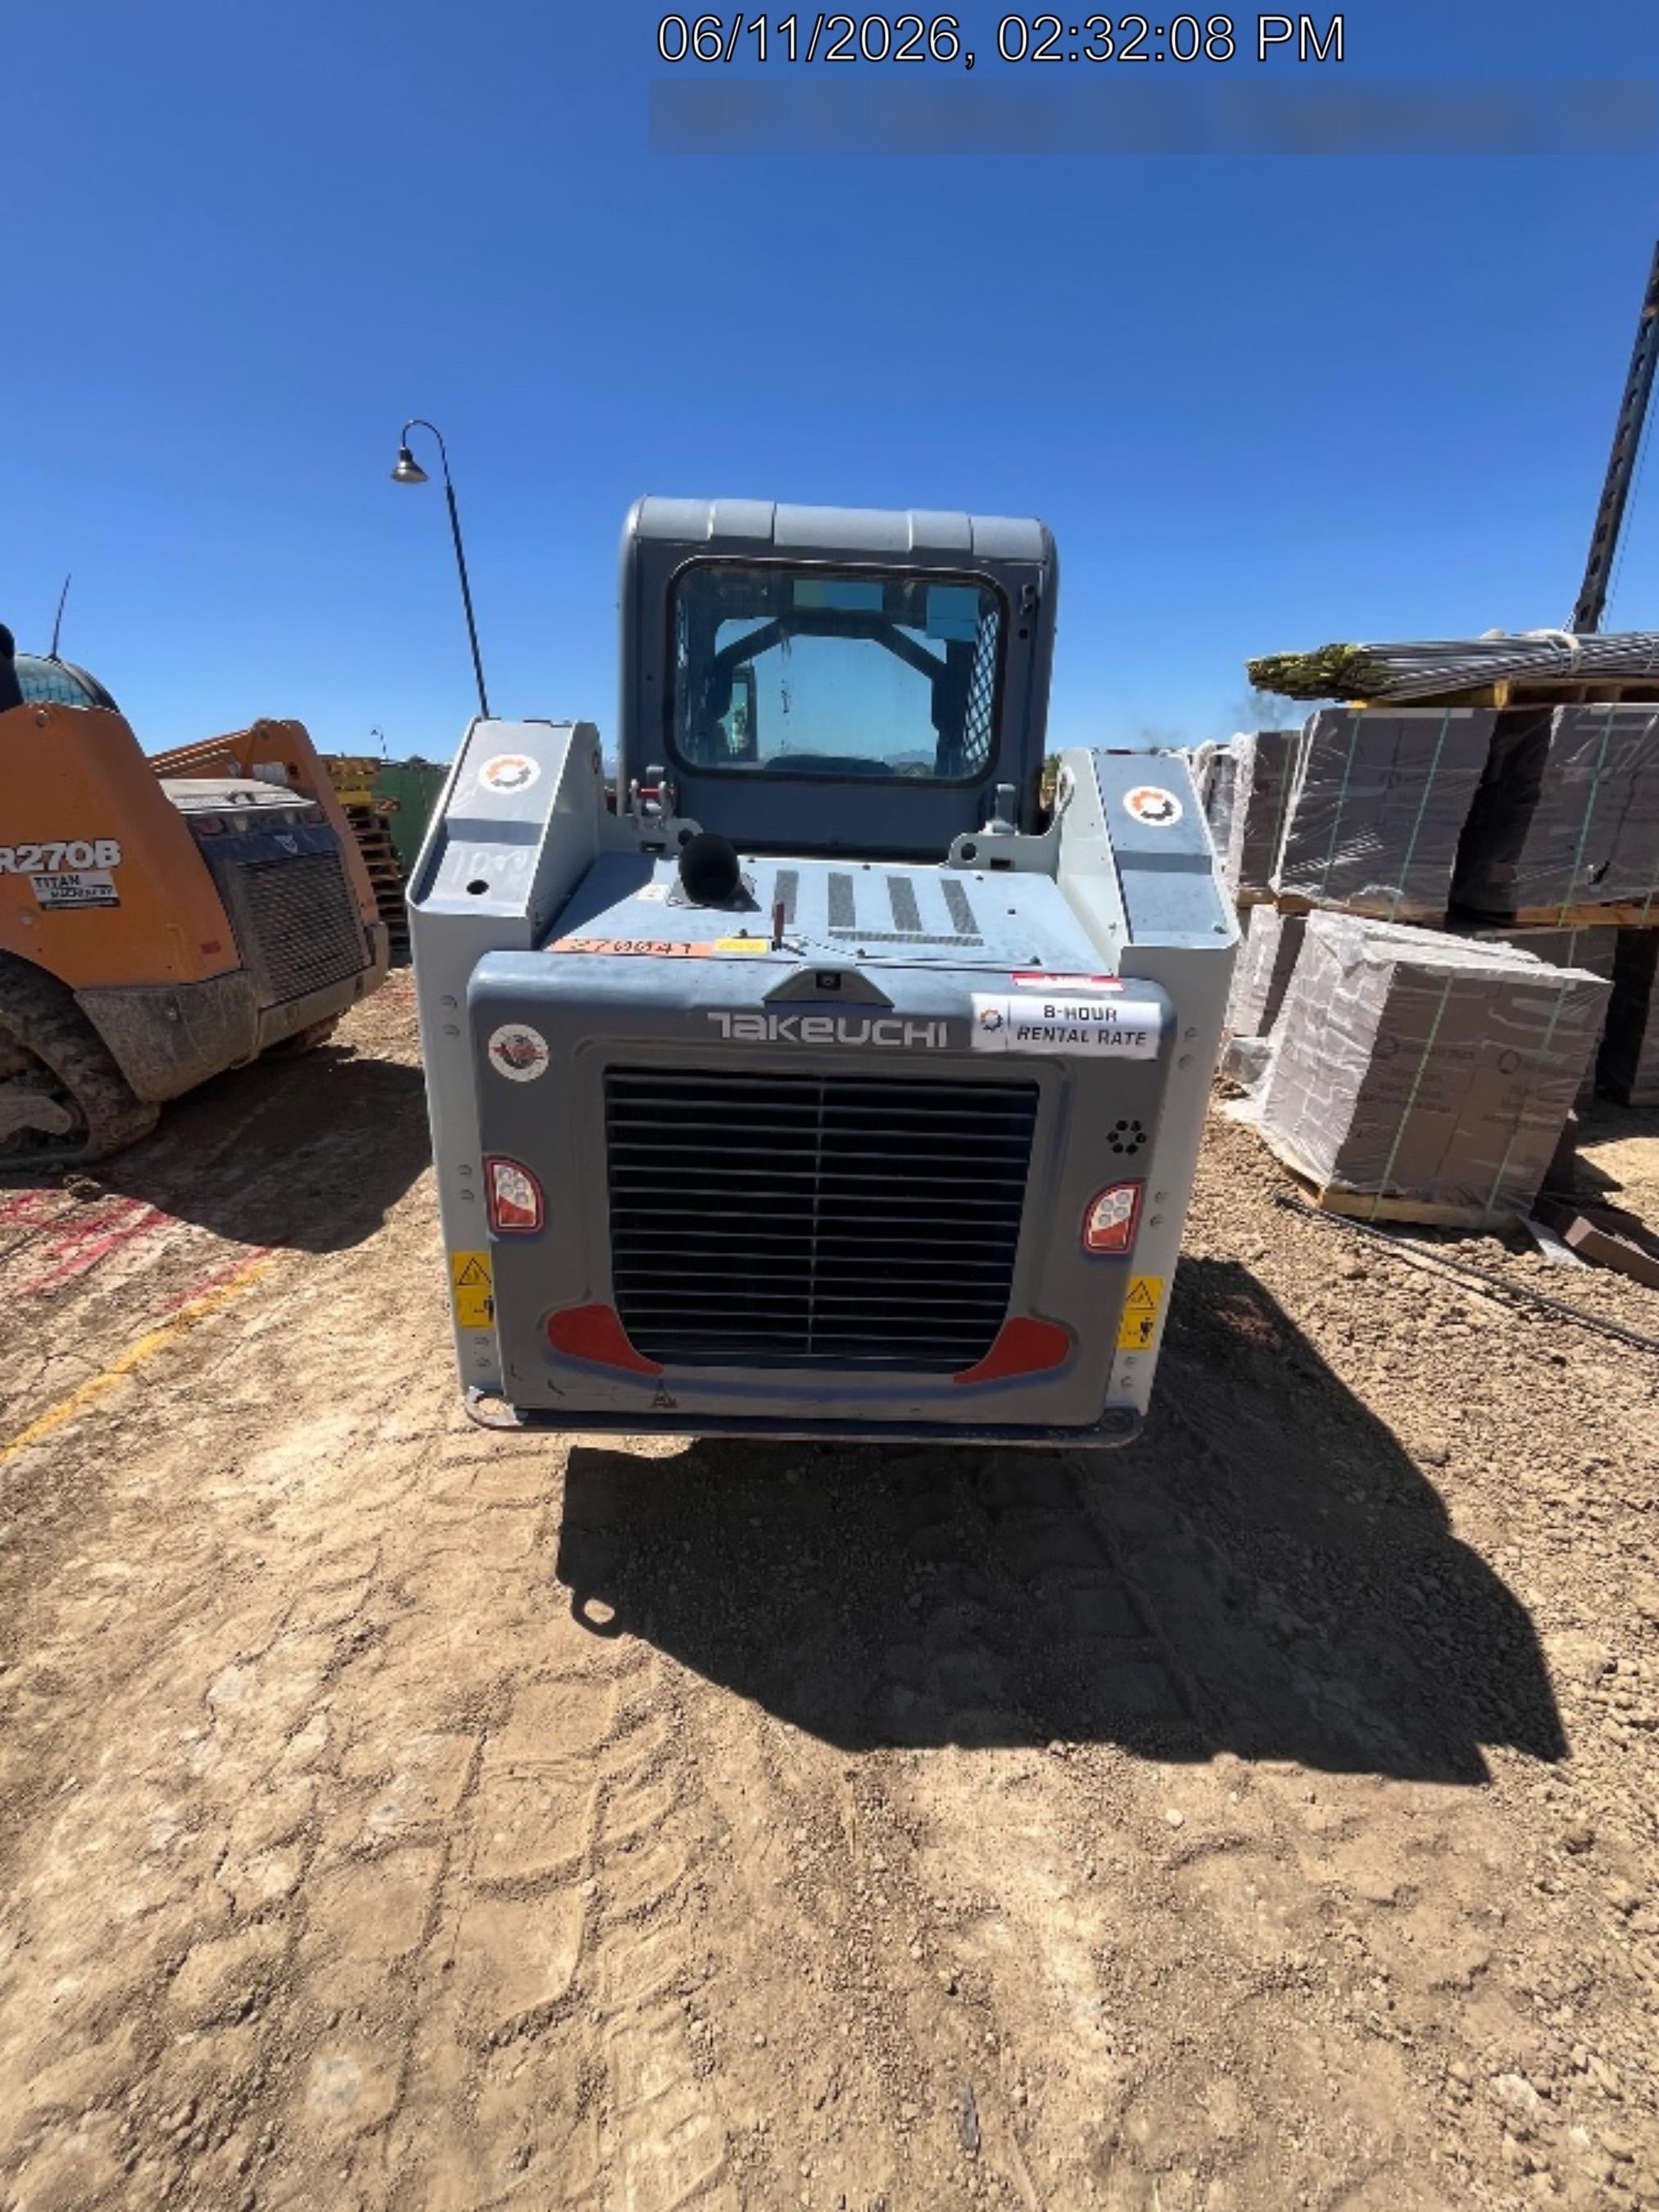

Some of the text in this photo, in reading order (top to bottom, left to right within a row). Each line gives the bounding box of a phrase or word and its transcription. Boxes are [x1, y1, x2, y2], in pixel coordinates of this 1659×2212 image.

[34, 874, 80, 888] TITAN
[1044, 1004, 1117, 1022] 8-HOUR
[1017, 1027, 1147, 1046] RENTAL RATE
